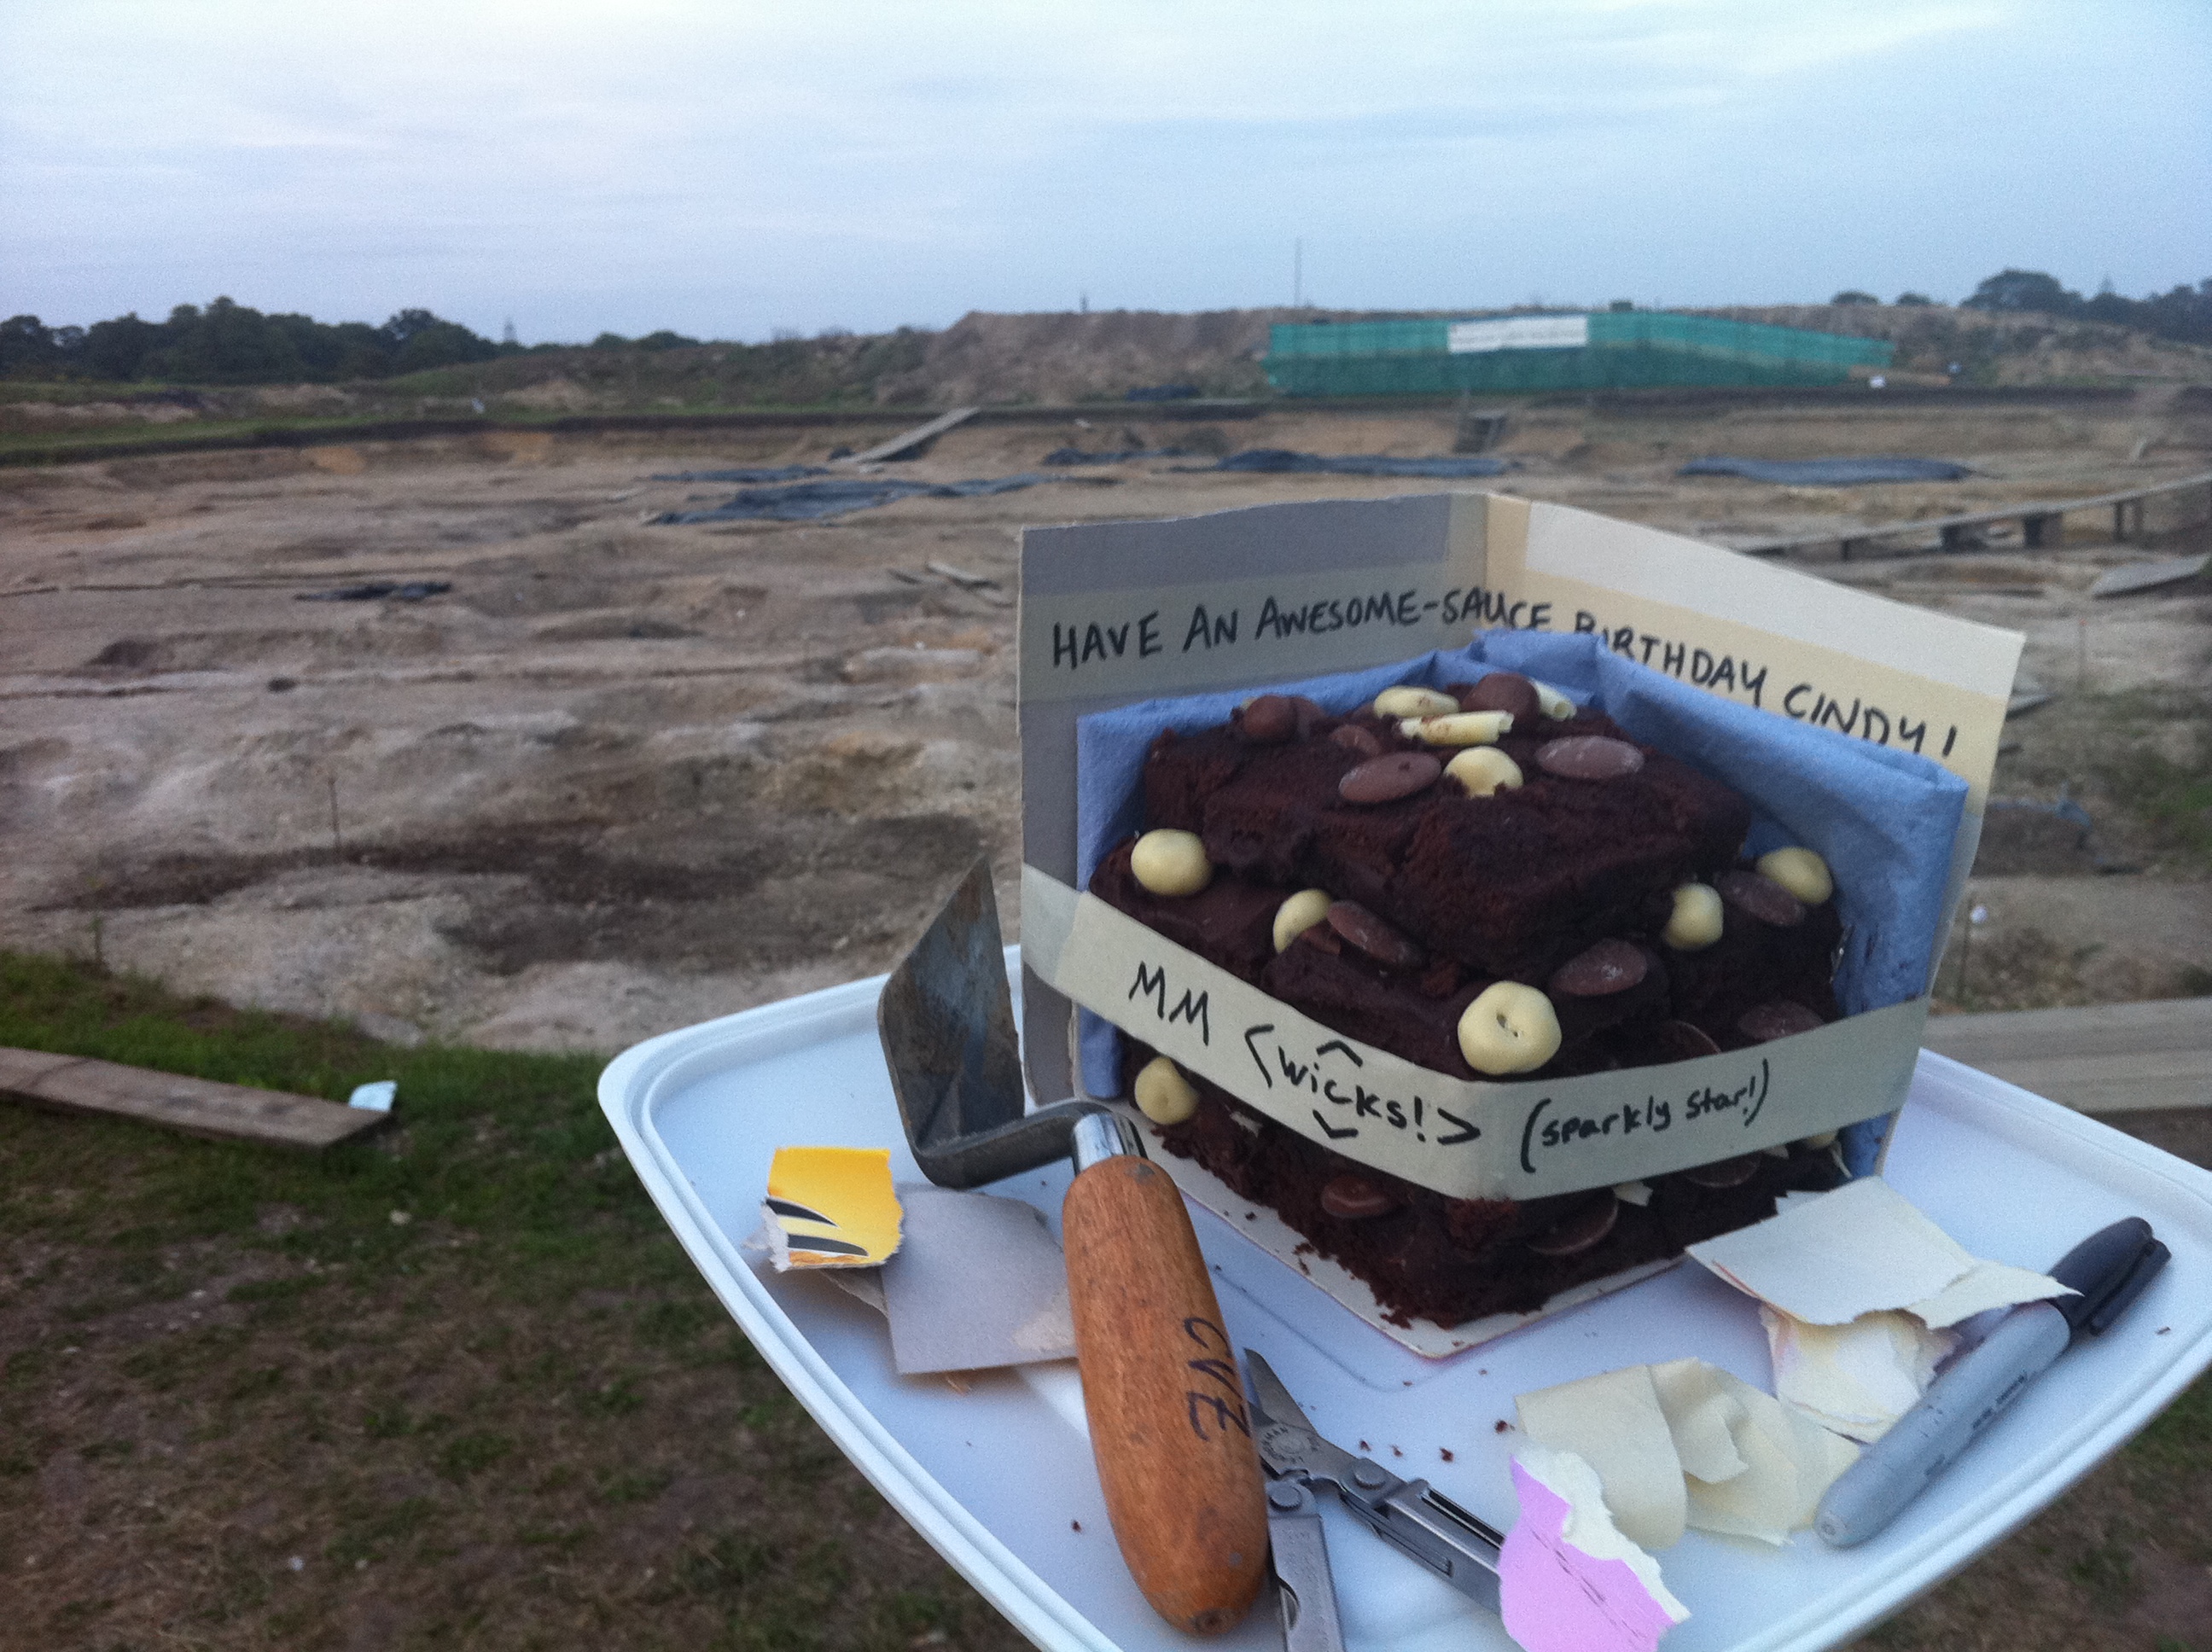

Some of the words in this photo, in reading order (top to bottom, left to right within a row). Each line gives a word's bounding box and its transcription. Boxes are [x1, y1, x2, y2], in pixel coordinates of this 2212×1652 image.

[1051, 609, 1163, 670] HAVE
[1182, 602, 1240, 653] AN
[1575, 610, 1768, 709] BIRTHDAY
[1127, 960, 1210, 1047] MM
